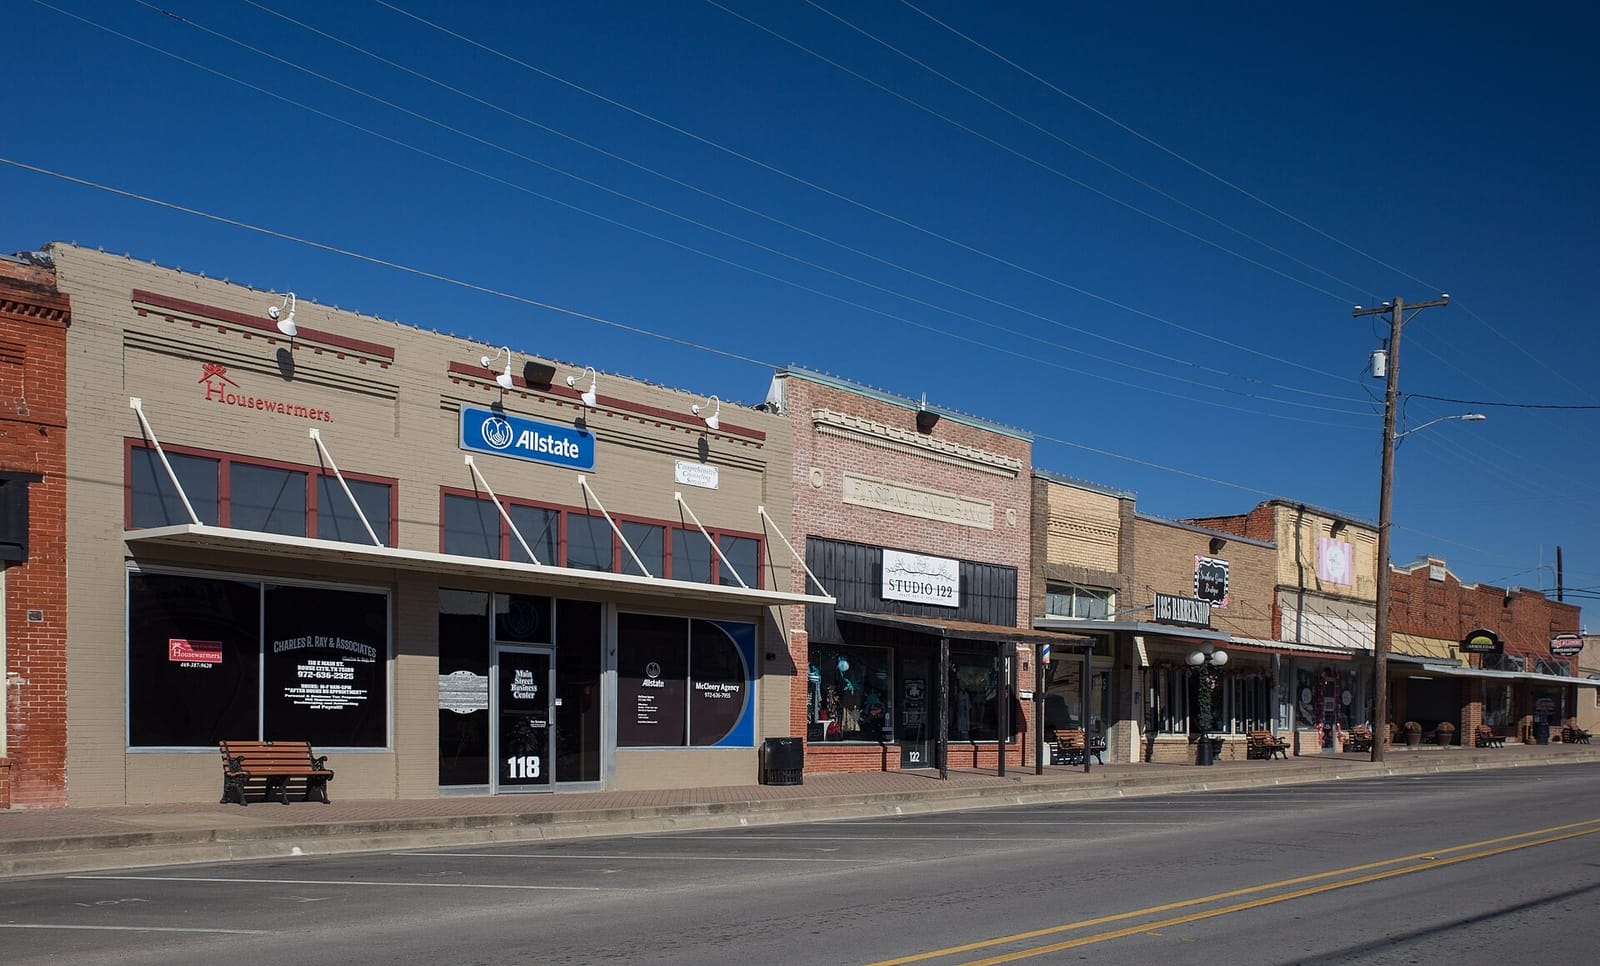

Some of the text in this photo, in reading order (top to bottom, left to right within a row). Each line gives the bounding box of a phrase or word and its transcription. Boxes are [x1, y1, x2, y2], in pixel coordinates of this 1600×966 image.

[515, 430, 579, 459] Allstate
[888, 578, 933, 595] STUDIO
[937, 584, 952, 598] 122
[1172, 597, 1210, 624] BARBERSHOP
[274, 636, 377, 658] CHARLES R. RAY & ASSOCIATES
[298, 671, 354, 680] 972-636-2325
[515, 669, 532, 678] Main
[511, 683, 537, 692] Business
[642, 679, 664, 688] Allstate
[695, 682, 740, 692] McCleery Agency
[909, 751, 920, 762] 122
[508, 756, 540, 778] 118
